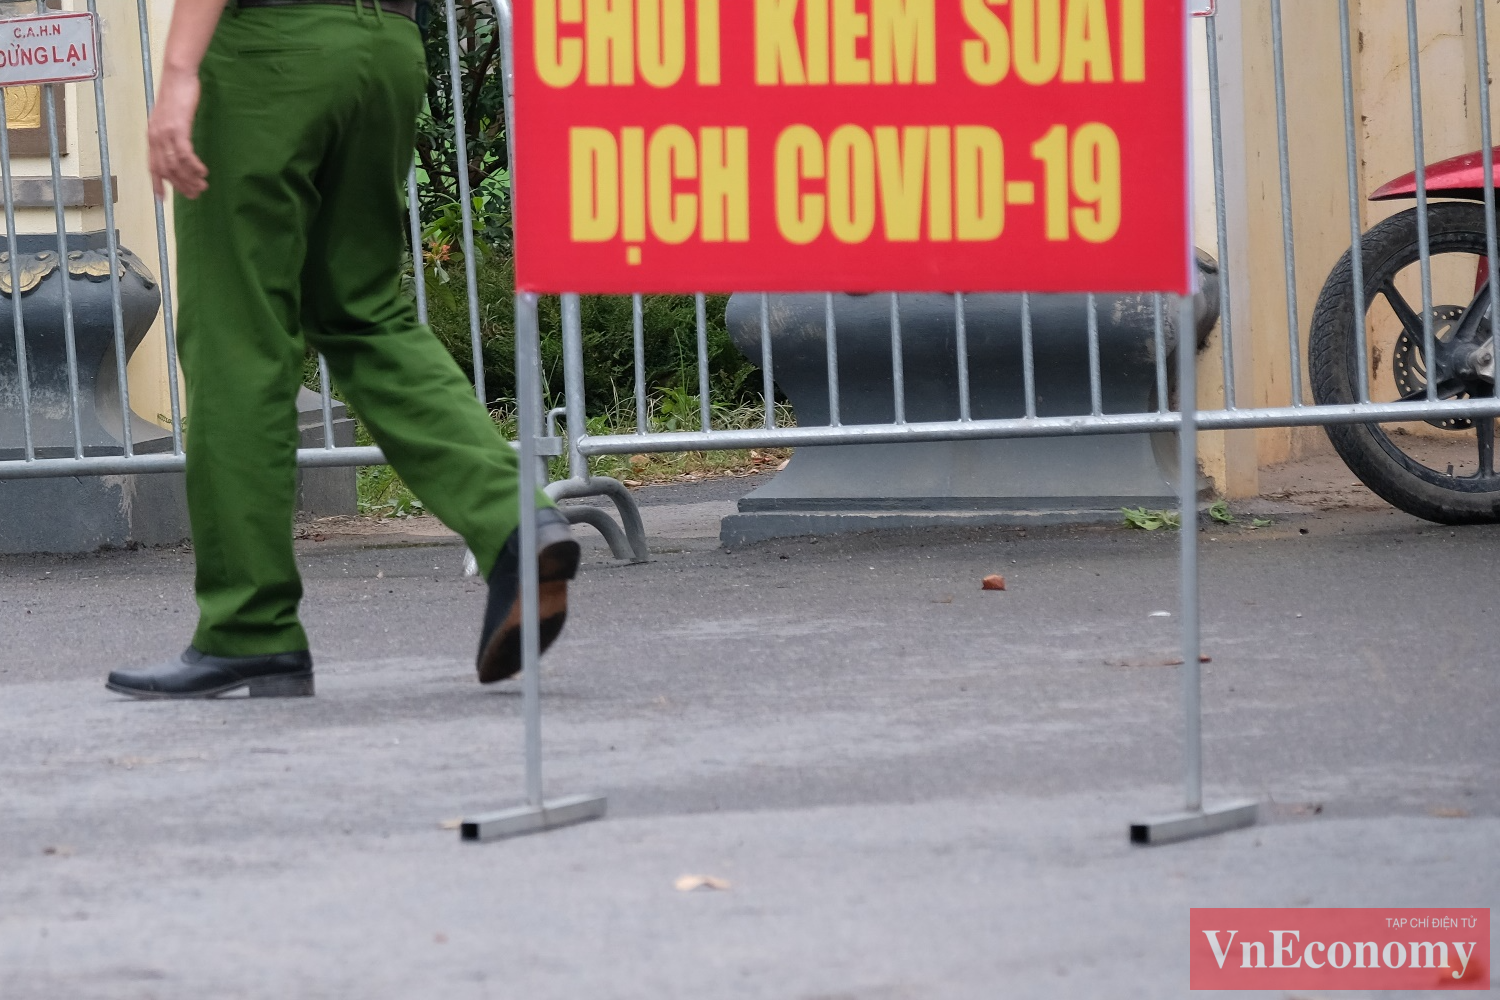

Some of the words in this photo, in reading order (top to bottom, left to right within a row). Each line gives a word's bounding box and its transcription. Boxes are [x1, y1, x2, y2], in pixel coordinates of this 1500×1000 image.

[52, 43, 87, 67] LẠI
[569, 124, 750, 266] DỊCH
[774, 122, 1122, 245] COVID-19
